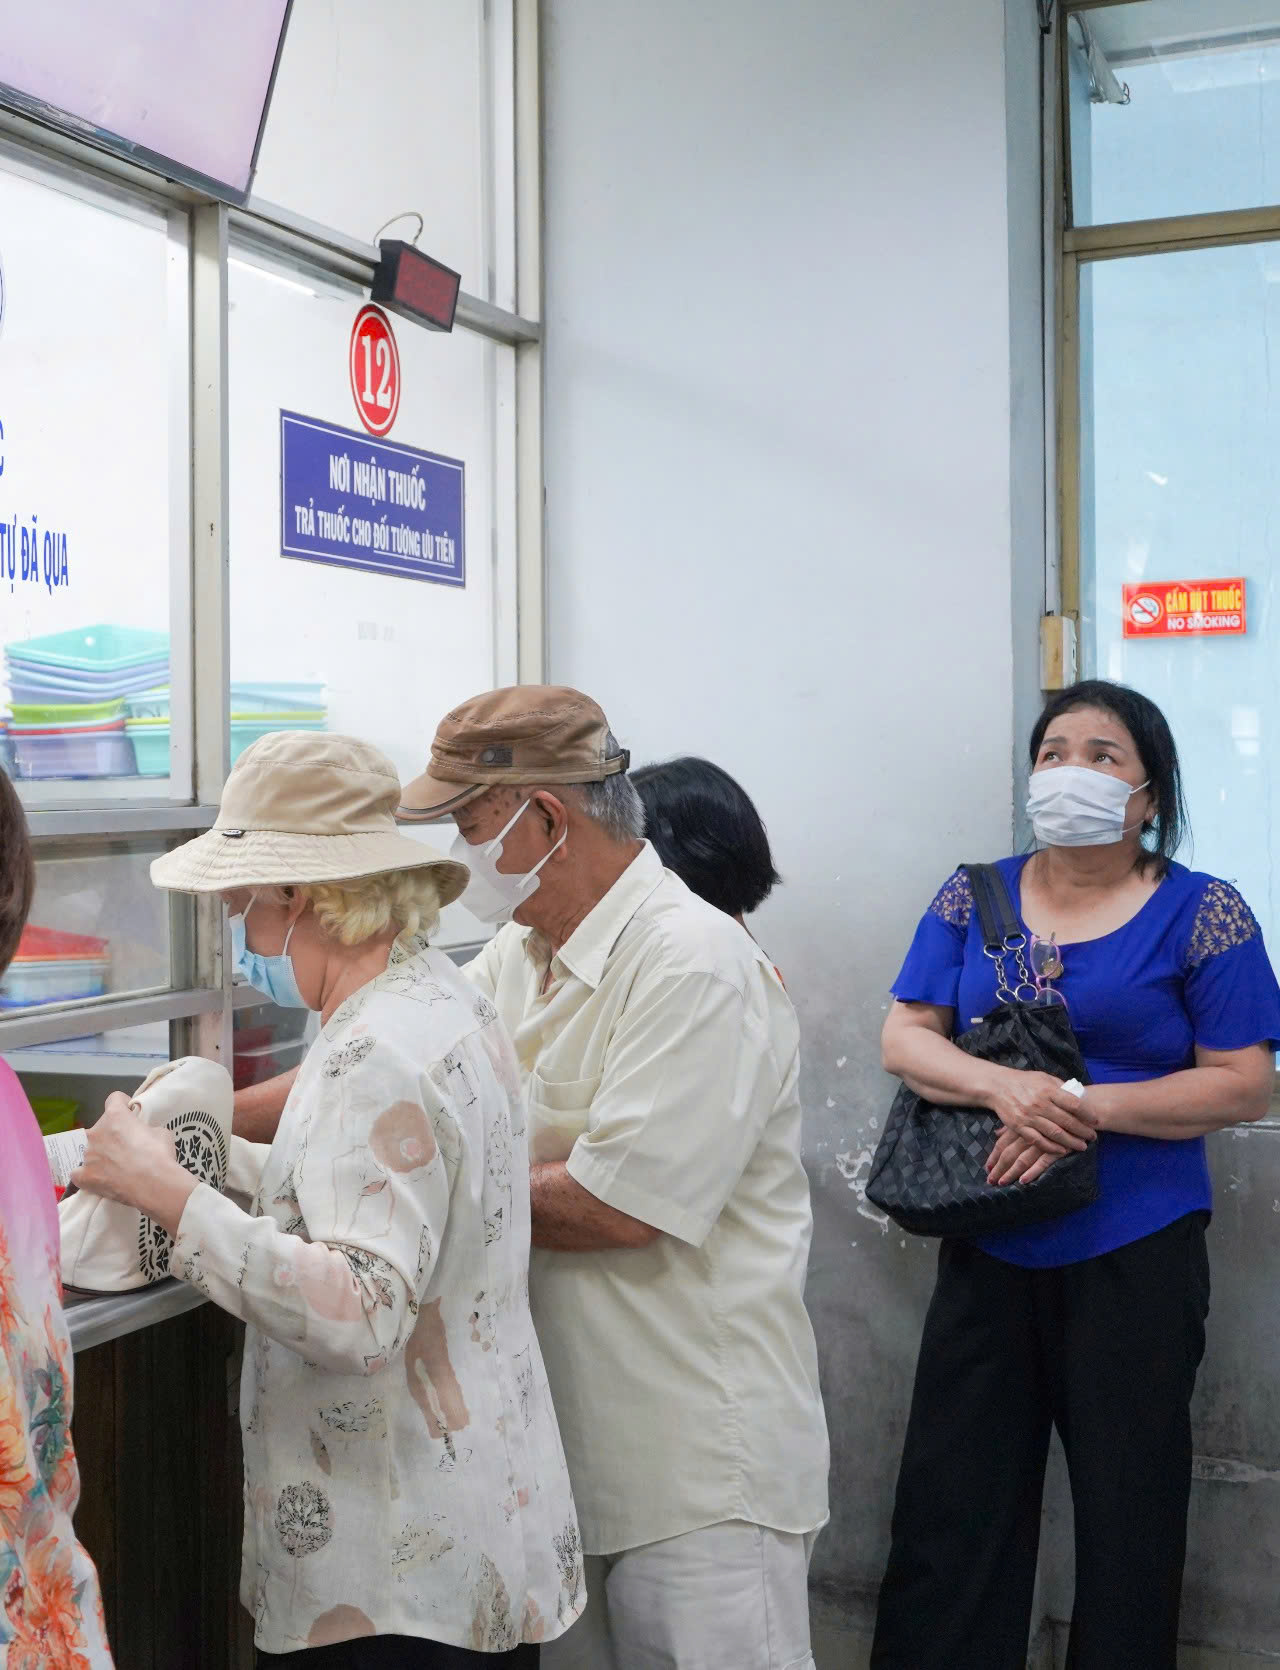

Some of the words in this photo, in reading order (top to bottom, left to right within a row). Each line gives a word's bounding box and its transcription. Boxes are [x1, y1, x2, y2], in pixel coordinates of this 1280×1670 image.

[361, 335, 392, 409] 12
[329, 453, 350, 493] NƠI
[354, 456, 386, 506] NHẬN
[388, 465, 426, 511] THUỐC
[21, 514, 39, 583] ĐÃ
[43, 530, 69, 596] QUA
[295, 498, 315, 537] TRẢ
[318, 505, 350, 543] THUỐC
[352, 517, 371, 548] CHO
[373, 515, 389, 551] ĐỐI
[391, 524, 420, 559] TƯỢNG
[422, 529, 434, 560] ƯU
[435, 532, 455, 564] TIÊN
[1166, 586, 1188, 613] CẤM
[1167, 617, 1185, 630] NO
[1187, 615, 1241, 629] SMOKING
